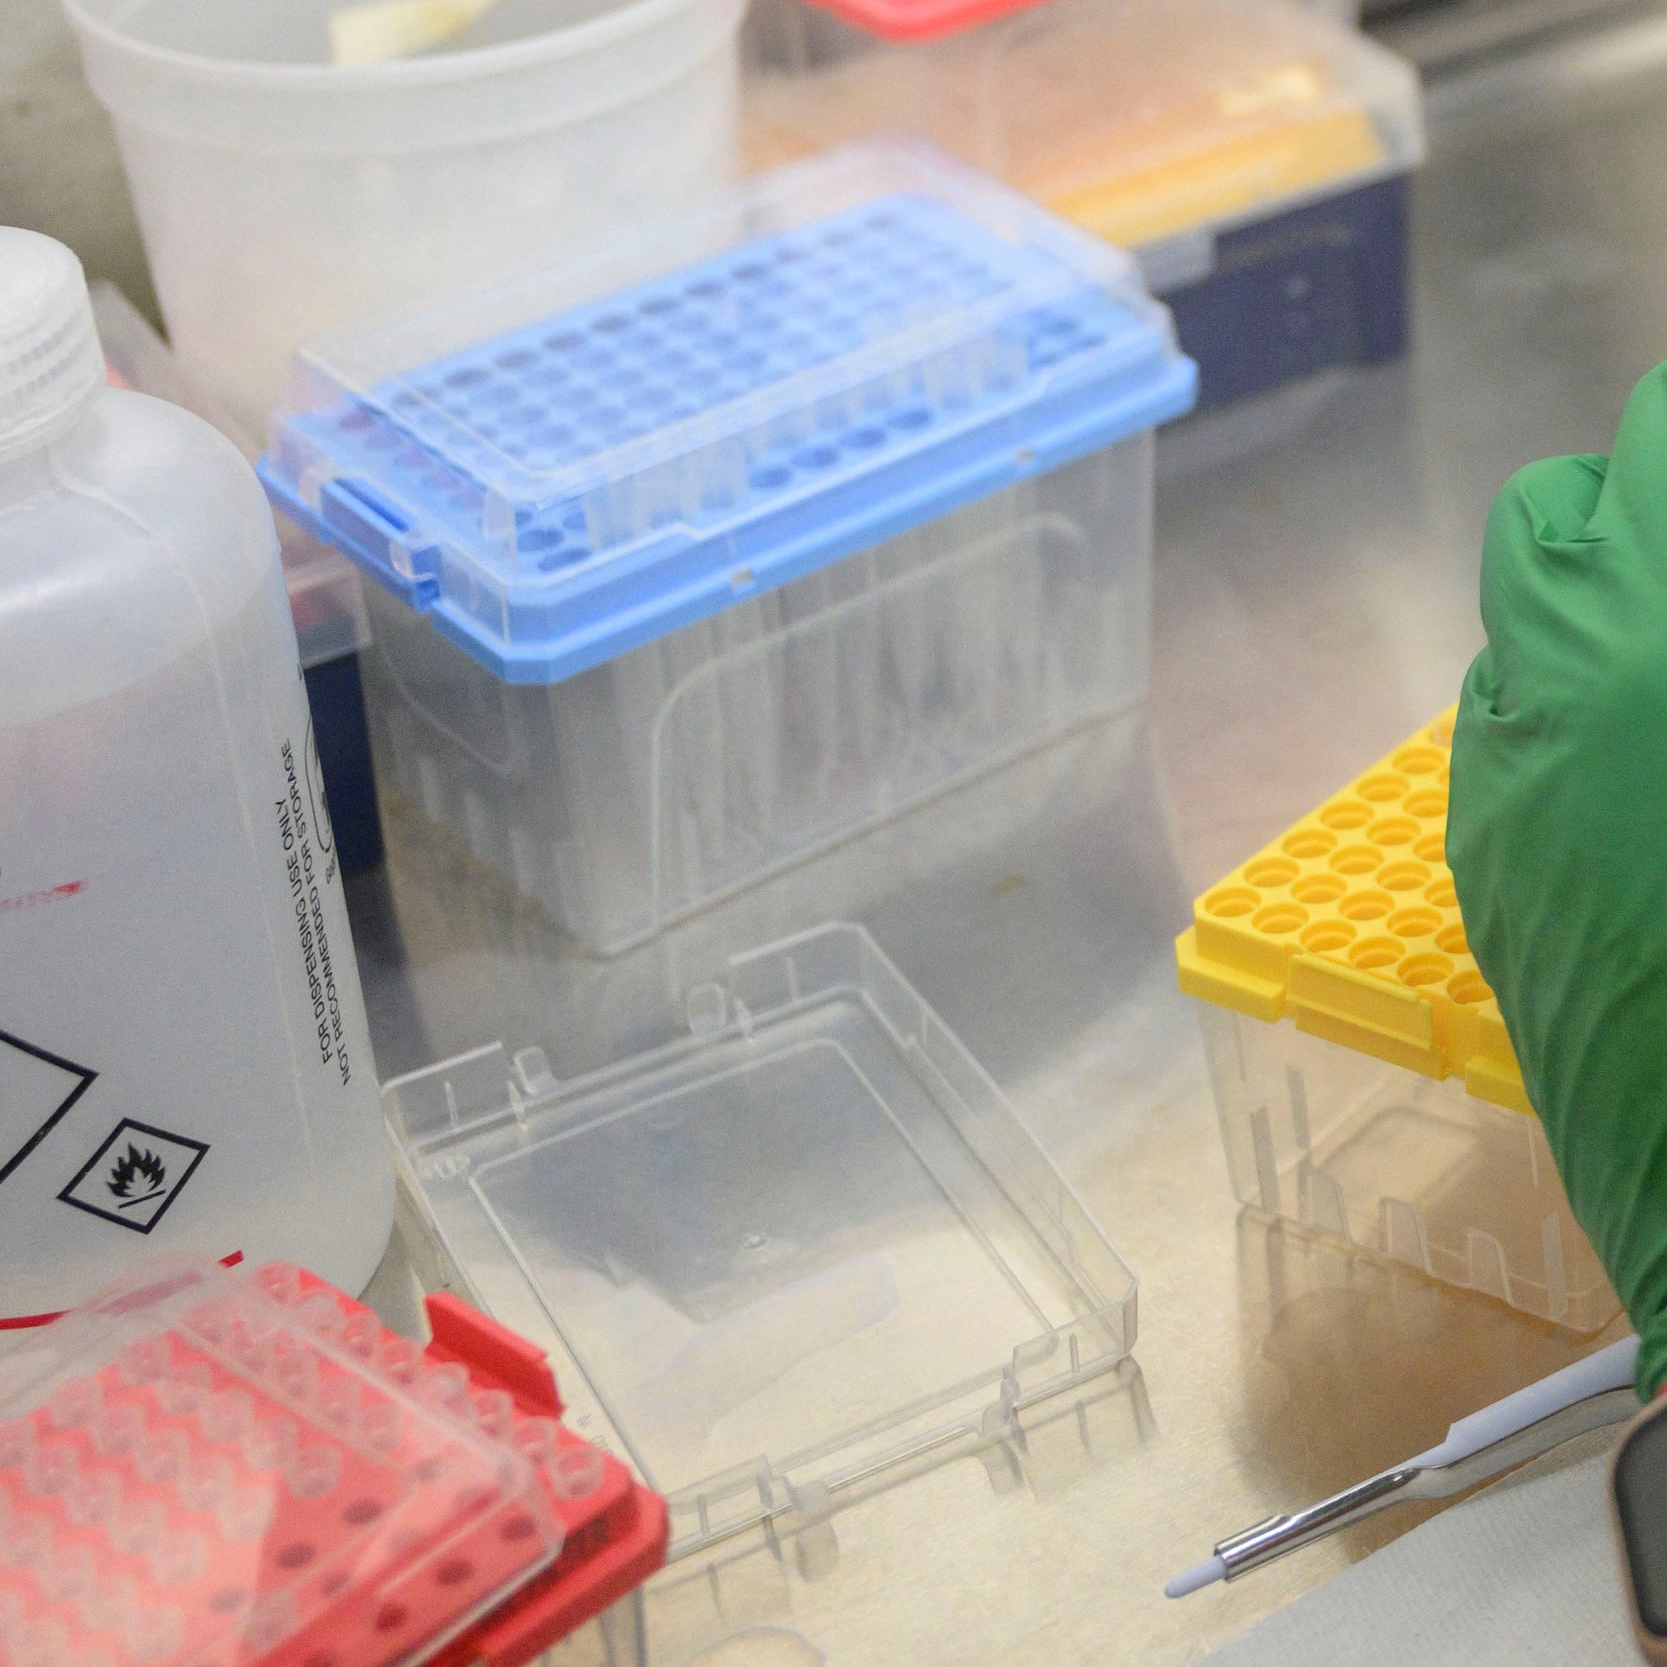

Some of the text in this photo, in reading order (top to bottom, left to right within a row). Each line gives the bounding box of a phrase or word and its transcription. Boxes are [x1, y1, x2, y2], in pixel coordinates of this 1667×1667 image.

[281, 738, 307, 838] STORAGE
[302, 839, 315, 887] FOR
[275, 798, 332, 1064] FOR DISPENSING USE ONLY
[309, 887, 343, 1042] RECOMMENDED
[336, 1043, 351, 1086] NOT
